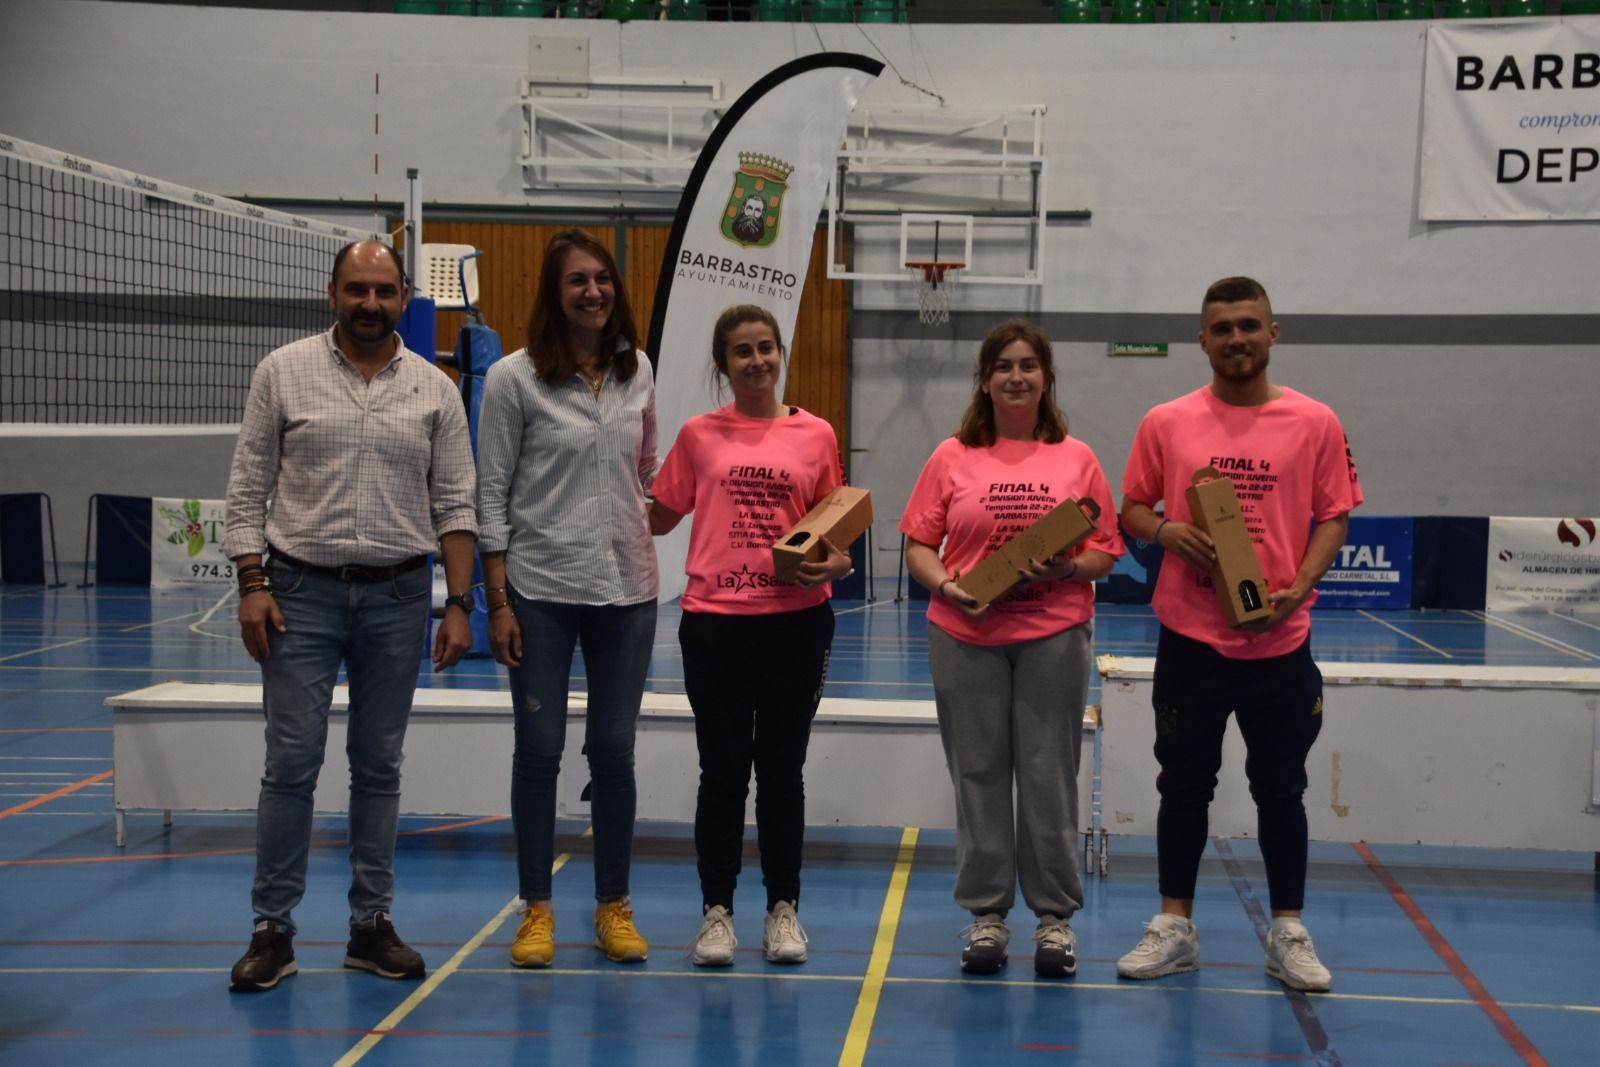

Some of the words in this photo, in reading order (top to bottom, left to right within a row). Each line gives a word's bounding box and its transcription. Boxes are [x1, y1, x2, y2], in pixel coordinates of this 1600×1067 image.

[1456, 53, 1600, 91] BARB
[1497, 147, 1600, 184] DEP
[679, 249, 797, 288] BARBASTRO
[677, 268, 793, 300] AYUNTAMIENTO
[1209, 456, 1255, 471] FINAL
[1260, 459, 1271, 472] 4
[729, 465, 775, 480] FINAL
[779, 469, 790, 481] 4
[729, 479, 764, 488] DIVISION
[988, 483, 1035, 493] FINAL
[1040, 483, 1050, 493] 4
[989, 494, 1025, 503] DIVISION
[1026, 495, 1057, 504] JUVENIL
[985, 503, 1028, 512] Temporada
[739, 511, 749, 519] LA
[750, 511, 776, 521] SALLE
[1332, 545, 1391, 568] TAL
[1522, 566, 1568, 575] ALMACEN
[1570, 567, 1583, 575] DE
[717, 574, 735, 588] La
